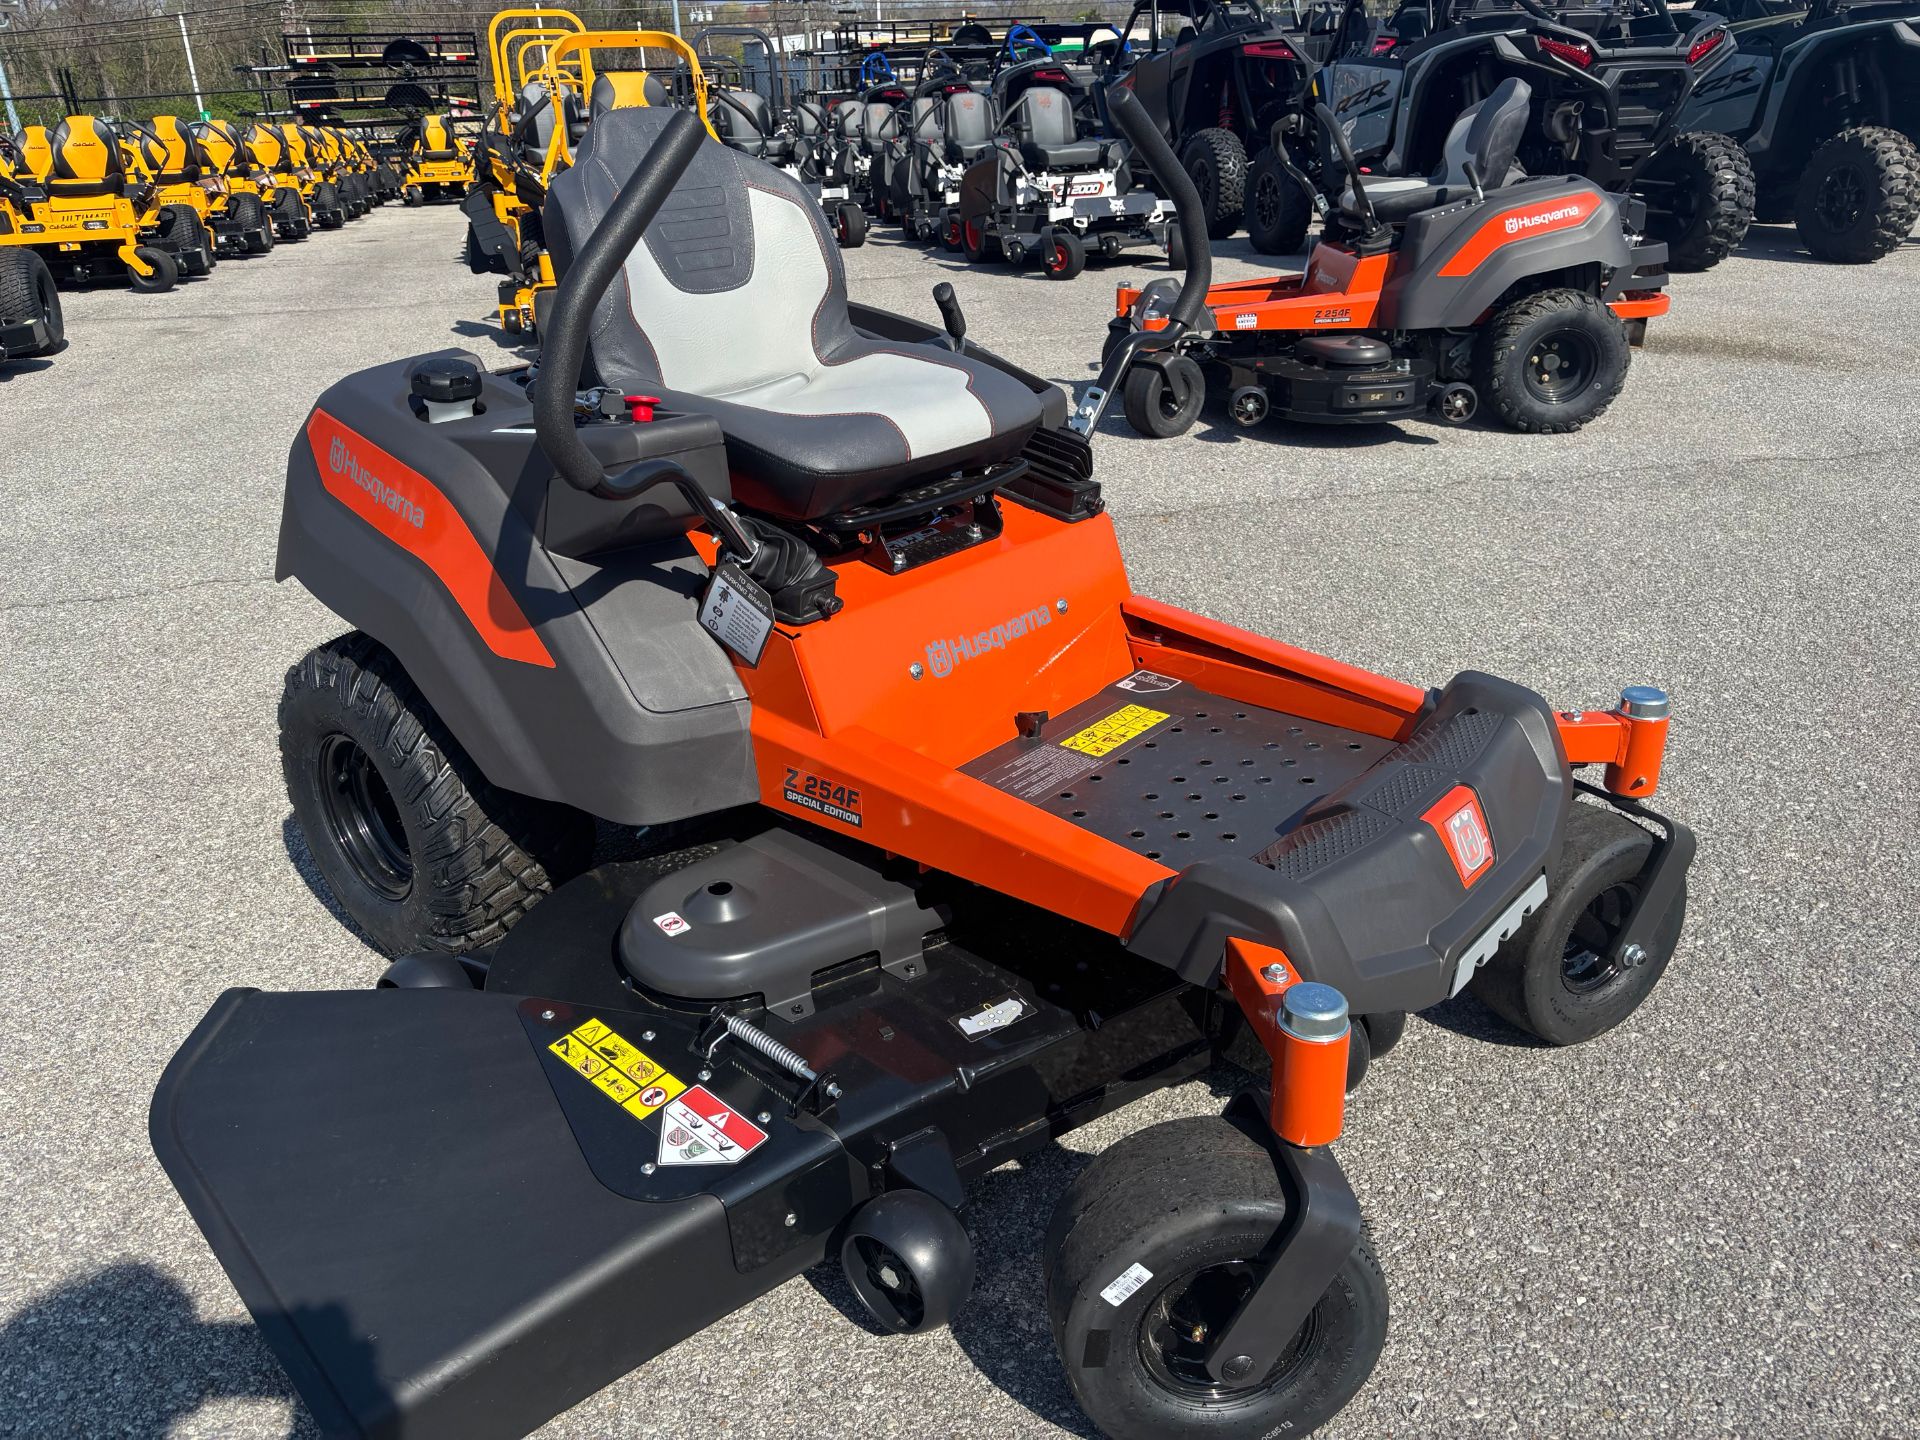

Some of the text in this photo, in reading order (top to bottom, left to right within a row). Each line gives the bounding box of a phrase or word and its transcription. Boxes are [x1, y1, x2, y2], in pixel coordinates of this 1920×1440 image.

[1072, 183, 1099, 195] 2000
[1518, 206, 1579, 229] Husqvarna
[1325, 308, 1350, 318] 254F
[343, 451, 425, 529] Husqvarna
[721, 569, 770, 614] PARKING BRAKE
[949, 605, 1051, 666] Husqvarna
[785, 767, 860, 809] Z 254F
[786, 790, 859, 825] SPECIAL EDITION
